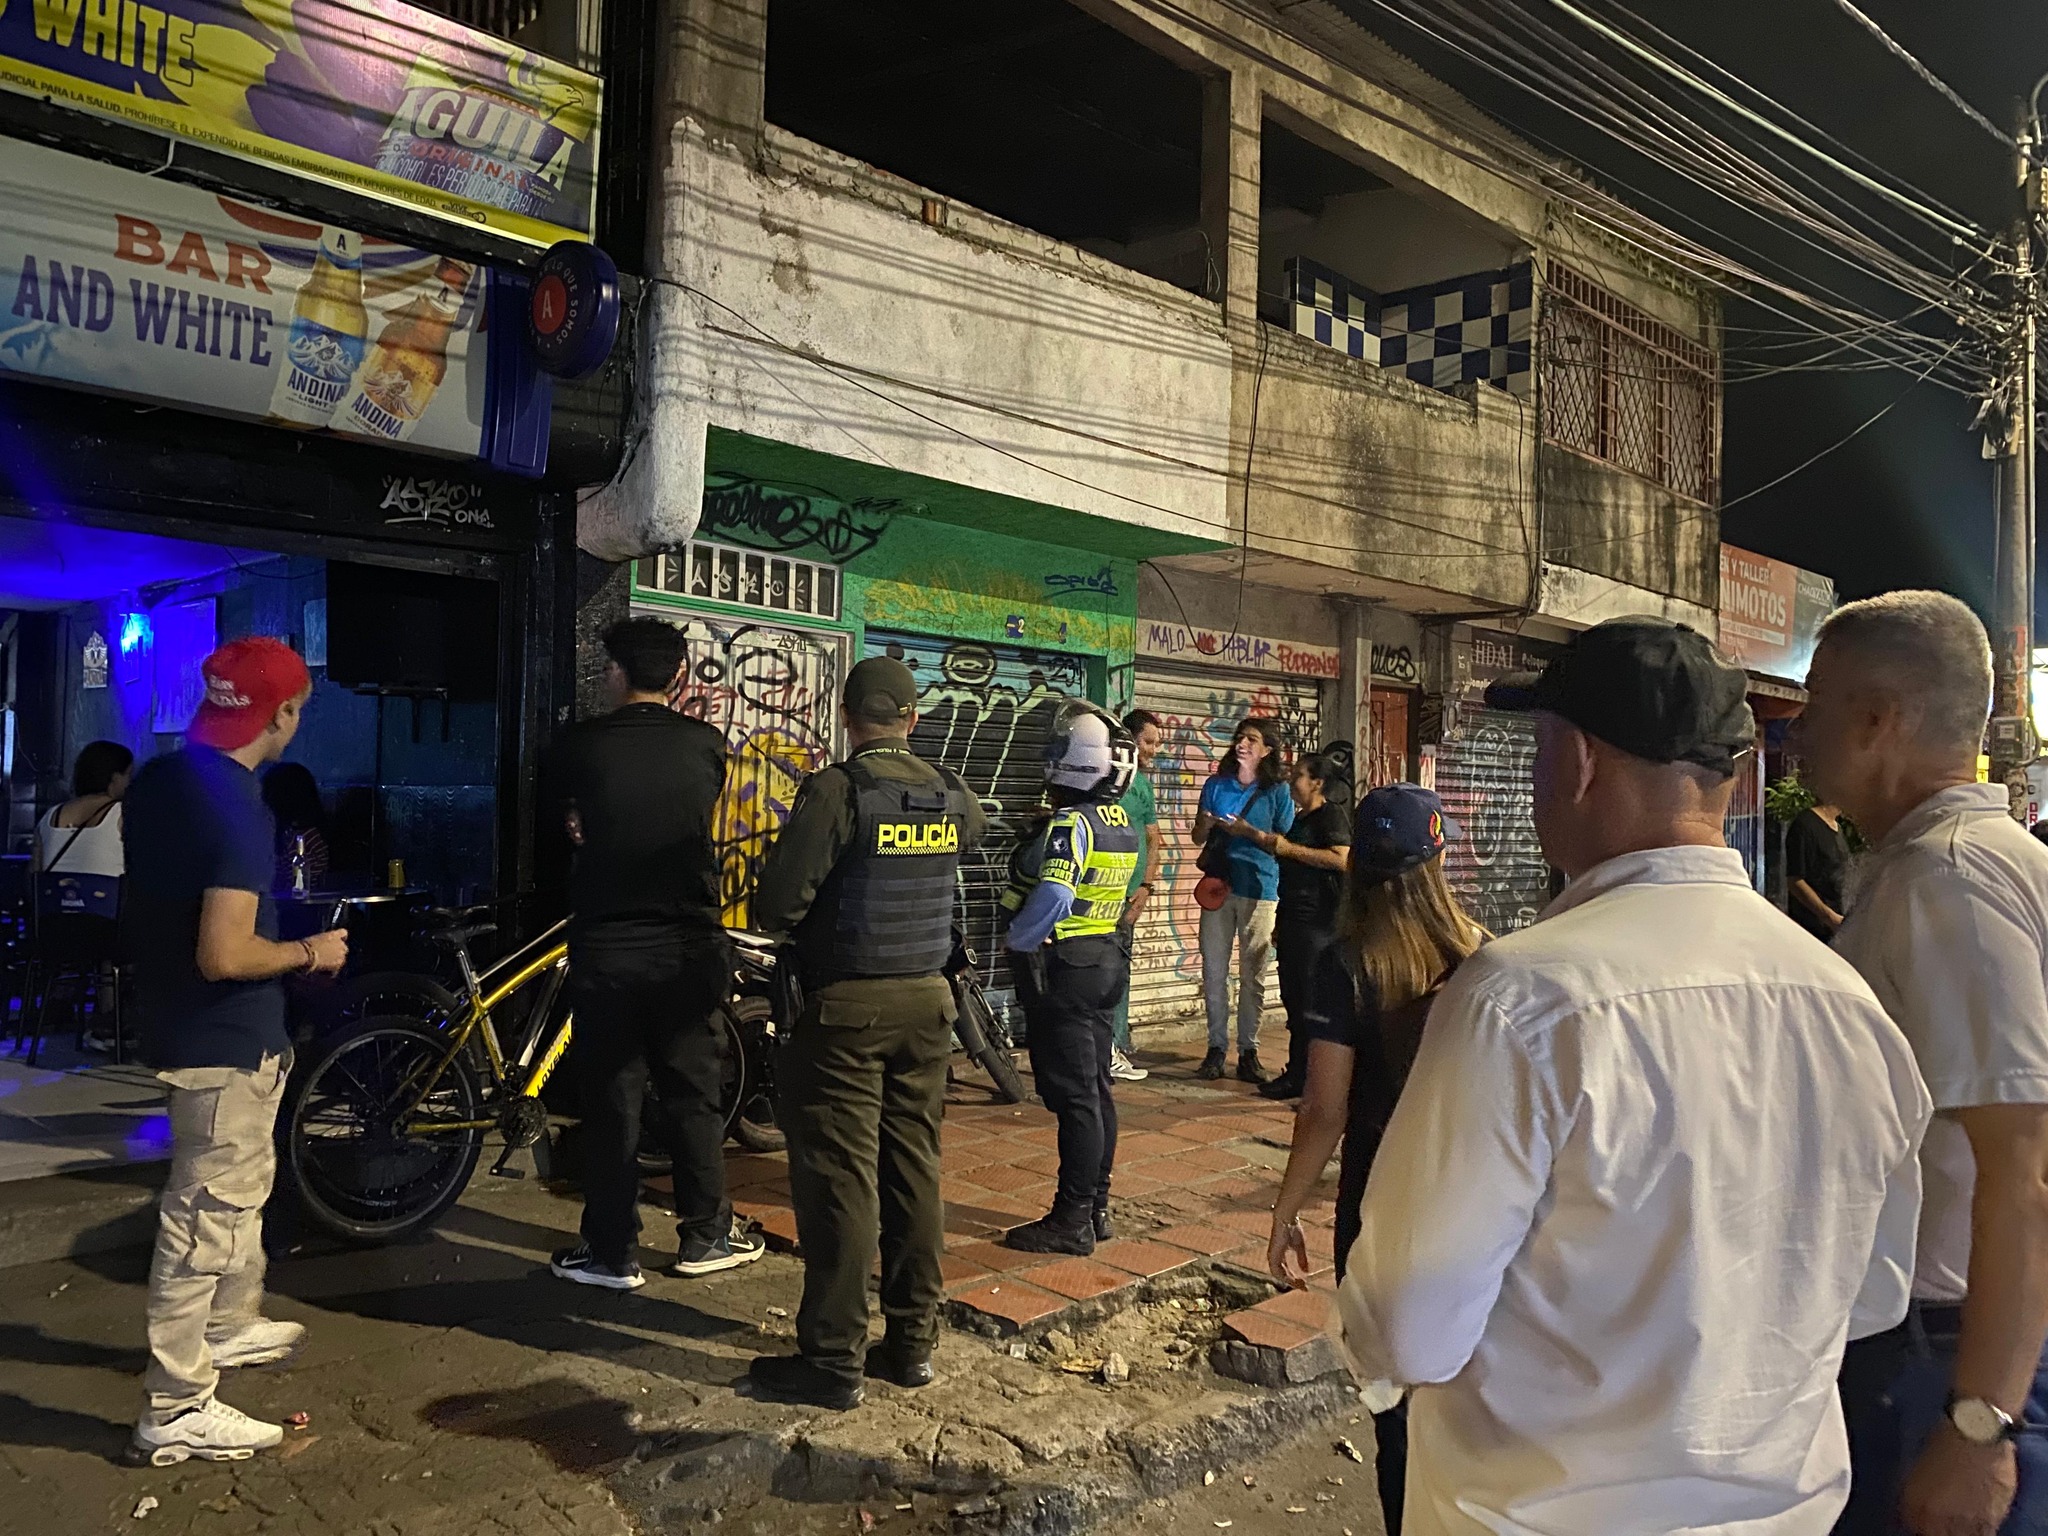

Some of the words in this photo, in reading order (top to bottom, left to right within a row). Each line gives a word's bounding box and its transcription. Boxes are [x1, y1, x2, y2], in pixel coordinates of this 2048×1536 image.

[33, 0, 196, 88] WHITE
[40, 82, 69, 99] PARA
[71, 90, 84, 102] LA
[179, 121, 190, 134] EL
[192, 127, 238, 149] EXPENDIO
[239, 140, 250, 151] DE
[252, 146, 290, 165] BEBIDAS
[291, 156, 355, 183] EMBRIAGANTES
[356, 176, 364, 185] A
[364, 179, 400, 198] MENORES
[403, 191, 414, 200] DE
[114, 213, 273, 295] BAR
[11, 254, 115, 333] AND
[129, 278, 274, 367] WHITE
[542, 290, 553, 320] A
[556, 299, 579, 345] SOMOS
[287, 368, 346, 403] ANDINA
[351, 392, 405, 439] ANDINA
[1731, 558, 1738, 577] Y
[1738, 560, 1770, 585] TALLER
[878, 814, 959, 848] POLICÍA
[1043, 867, 1075, 883] SPORTE
[1048, 858, 1070, 870] SITO
